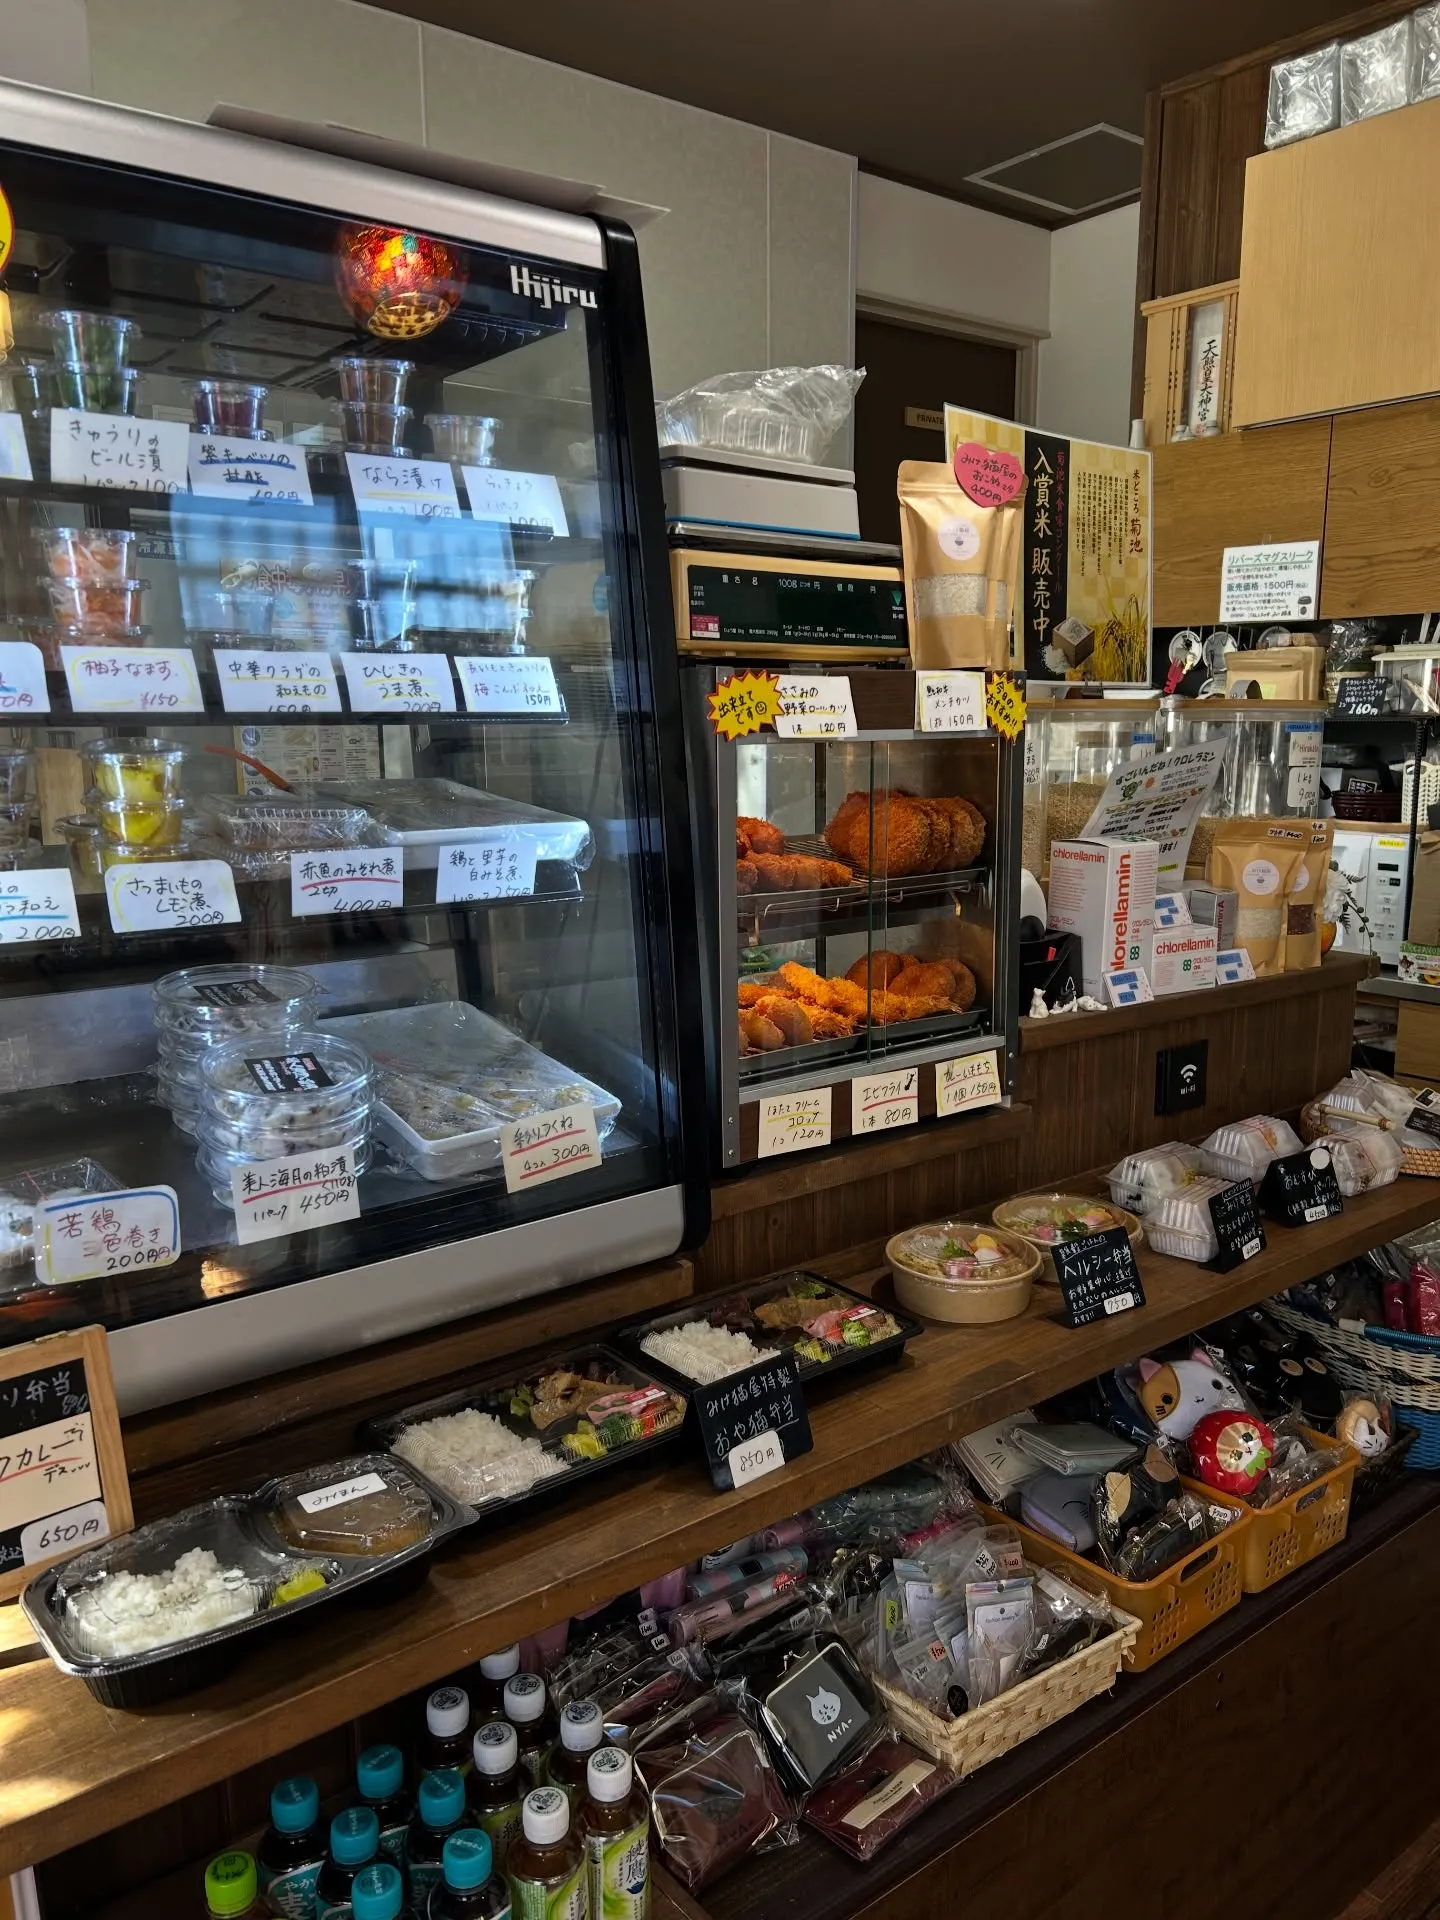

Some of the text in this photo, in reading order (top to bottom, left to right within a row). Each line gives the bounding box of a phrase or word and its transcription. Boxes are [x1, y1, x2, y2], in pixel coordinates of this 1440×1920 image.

[510, 265, 598, 309] Hijiru
[917, 413, 944, 424] PRIVATE
[69, 420, 160, 446] きゅうりの
[362, 465, 442, 490] なら漬け
[971, 484, 1002, 502] 400円
[1032, 446, 1055, 642] 入賞米販売中
[1264, 580, 1293, 589] 1500円
[228, 661, 321, 680] 中華クラゲの
[363, 663, 423, 679] ひじきの
[276, 684, 327, 698] 和えもの
[819, 722, 846, 734] 120円
[948, 715, 974, 727] 150円
[1053, 849, 1105, 863] chlorellamin
[300, 858, 398, 879] 赤魚のみぞれ煮
[127, 876, 203, 896] さつまいもの
[309, 886, 337, 897] 2切
[176, 911, 224, 926] 200円
[1156, 937, 1214, 955] chlorellamin
[863, 1081, 902, 1101] エビフライ
[970, 1083, 997, 1095] 150円
[884, 1107, 912, 1125] 80円
[792, 1128, 824, 1142] 120円
[551, 1143, 590, 1164] 300円
[300, 1190, 350, 1214] 450円
[58, 1207, 121, 1240] 若鶏
[1064, 1244, 1132, 1279] ヘルシー弁当
[740, 1447, 775, 1471] 850円
[40, 1519, 99, 1548] 650円
